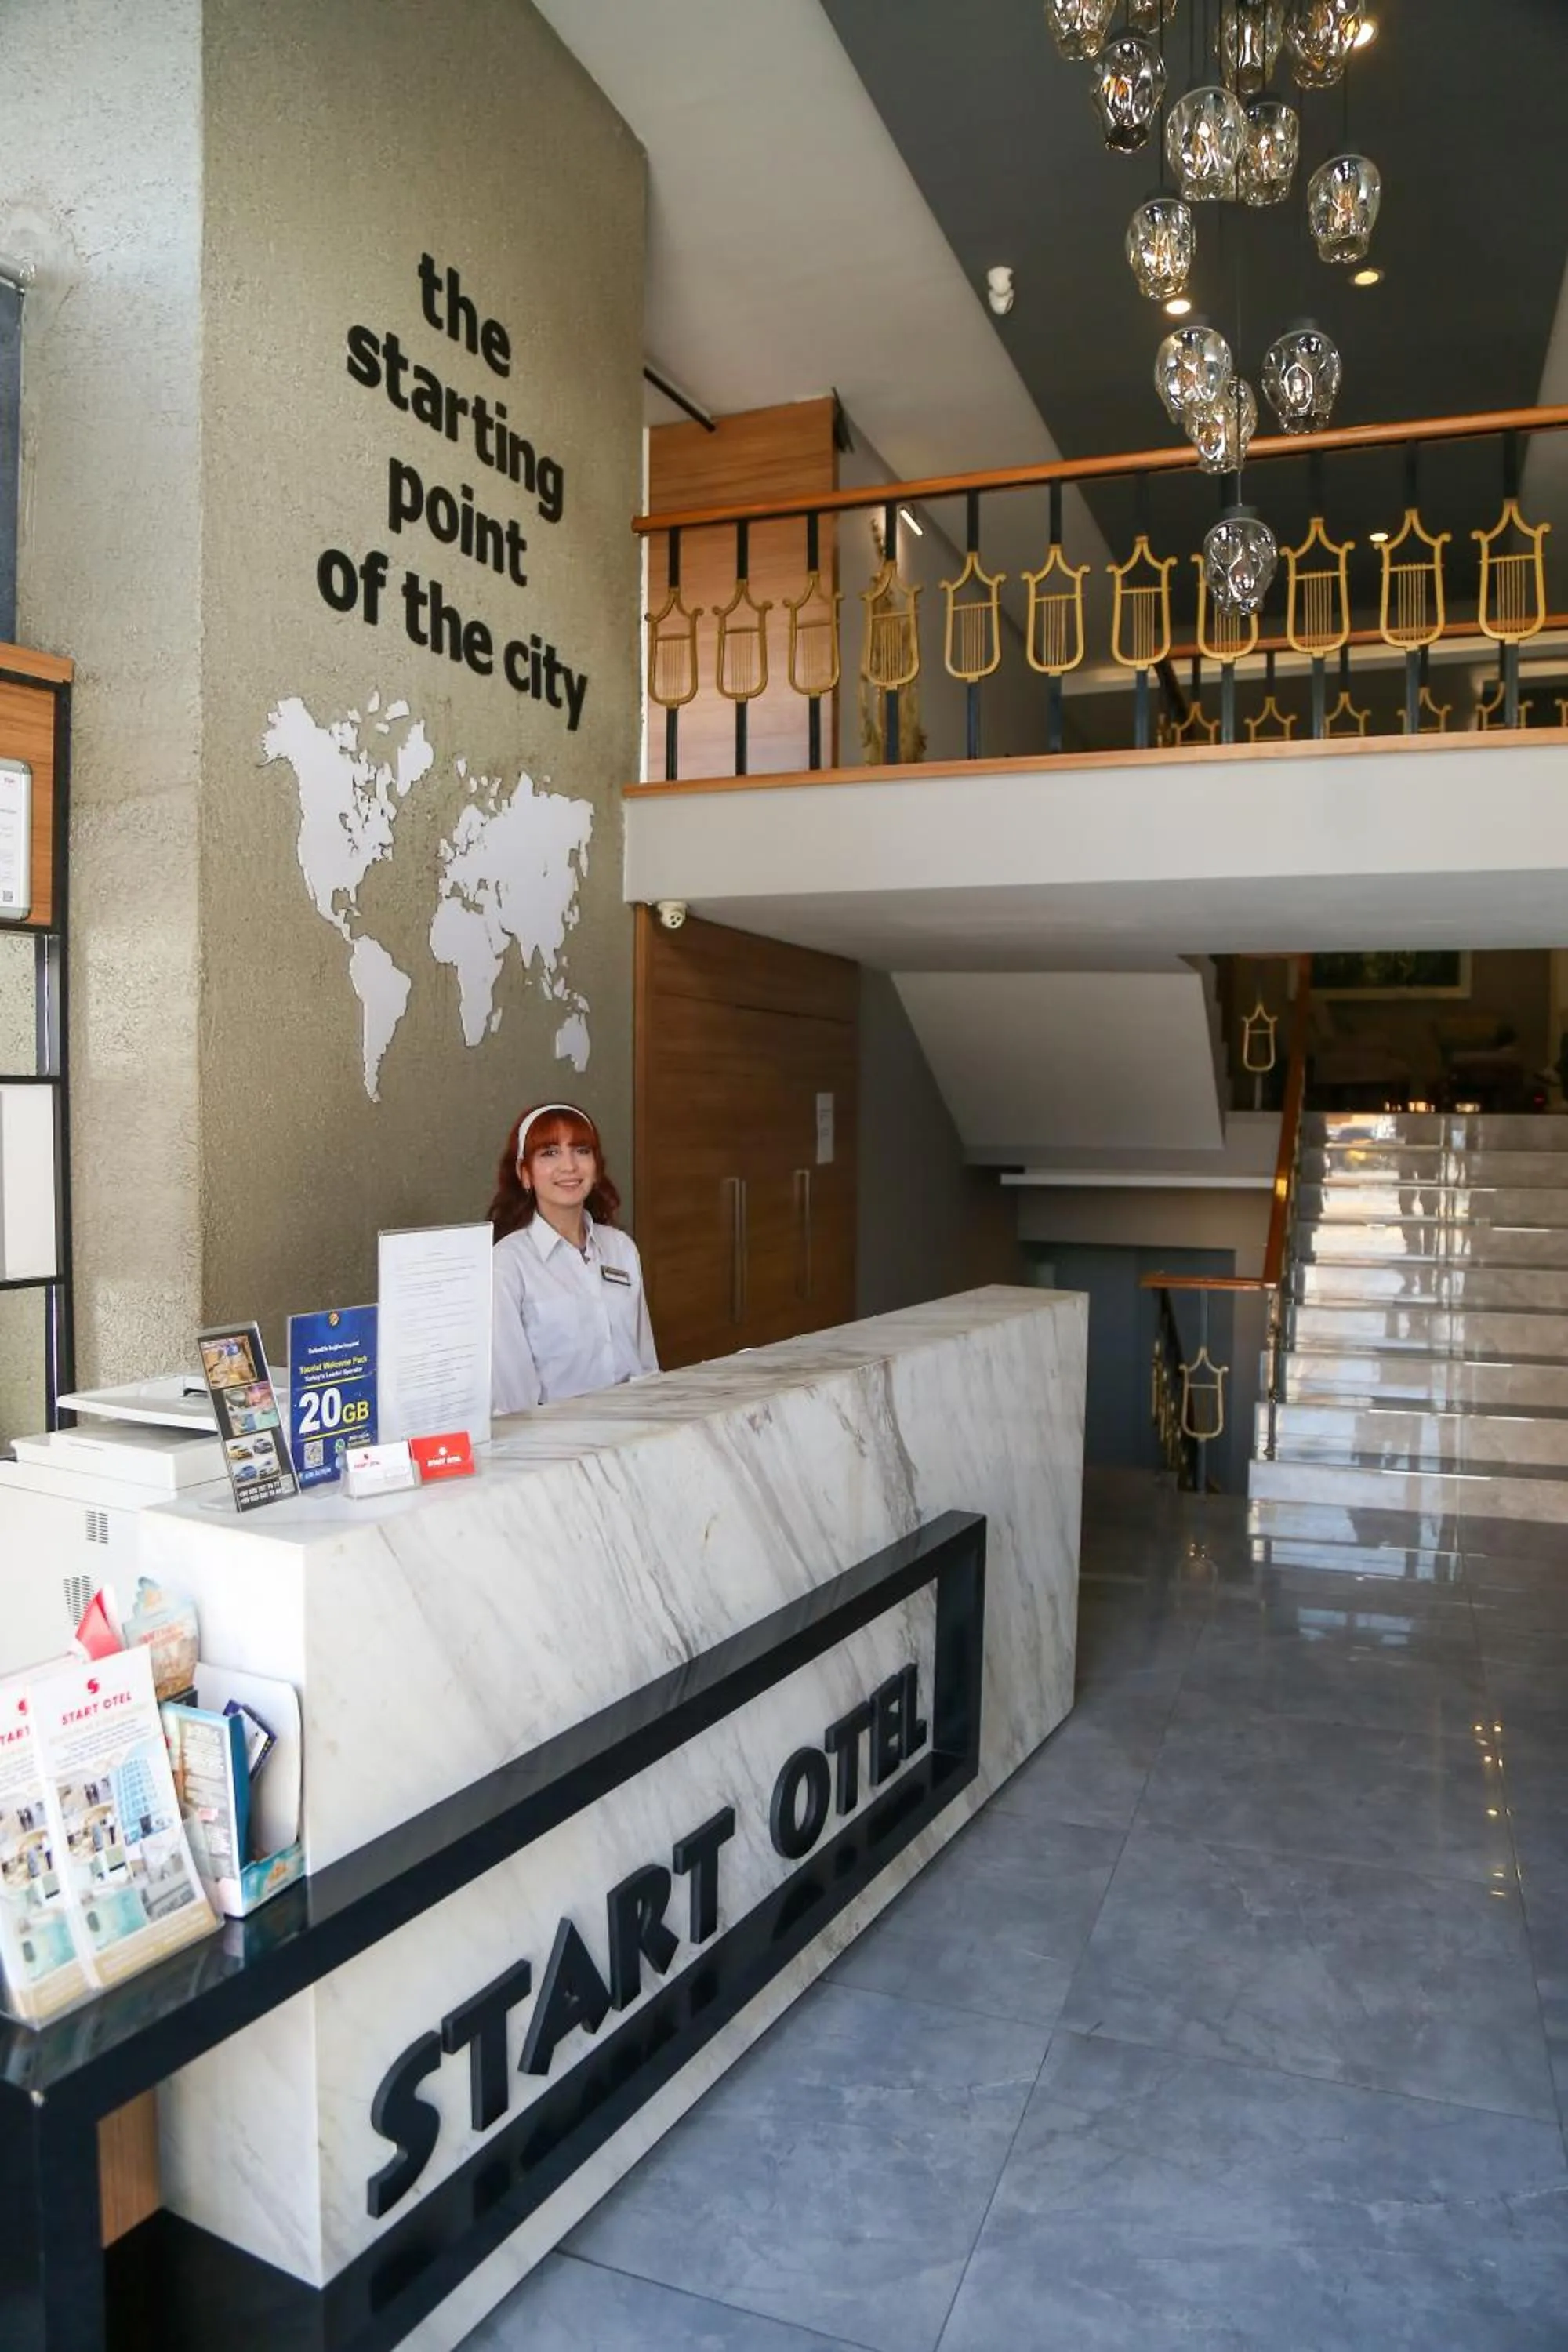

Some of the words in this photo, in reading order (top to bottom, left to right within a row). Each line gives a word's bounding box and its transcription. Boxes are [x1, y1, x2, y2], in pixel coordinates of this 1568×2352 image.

[418, 252, 510, 378] the
[347, 325, 564, 523] starting
[388, 457, 528, 587] point
[316, 549, 389, 626] of
[401, 571, 493, 676] the
[503, 633, 588, 731] city
[0, 1726, 30, 1745] TART
[61, 1704, 99, 1725] START
[366, 1806, 735, 2219] START
[769, 1663, 927, 1860] OTEL
